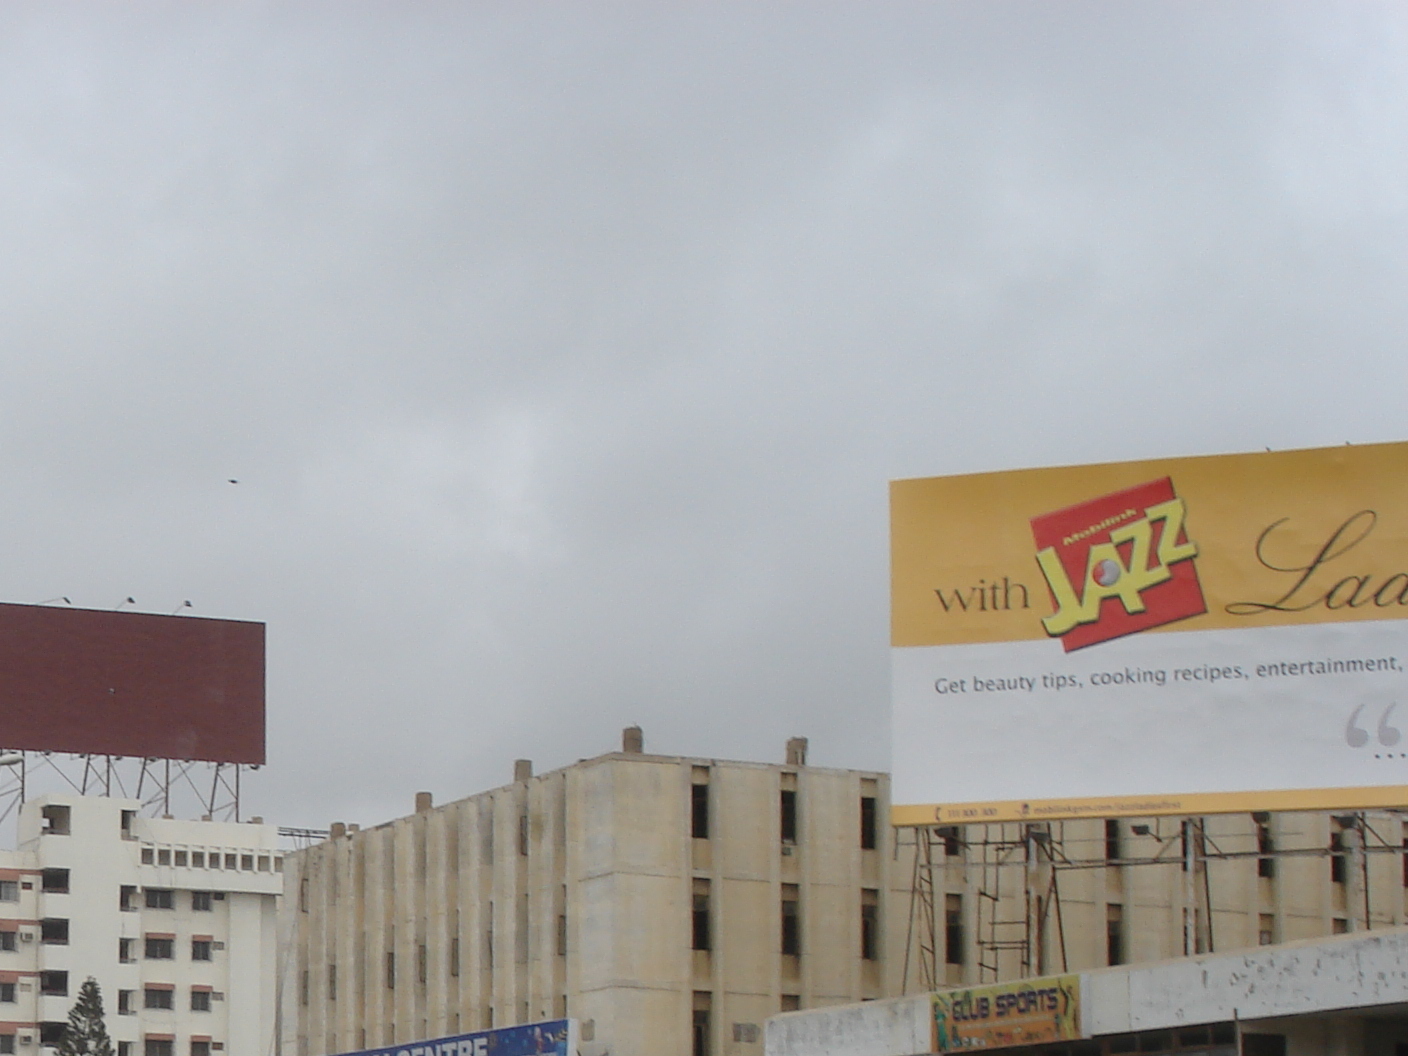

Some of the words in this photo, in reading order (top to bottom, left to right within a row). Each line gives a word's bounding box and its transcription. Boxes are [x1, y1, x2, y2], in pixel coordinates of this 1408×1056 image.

[934, 576, 1030, 613] with
[1036, 497, 1199, 638] JAZZ
[934, 676, 967, 695] Get
[973, 675, 1036, 692] beauty
[1041, 672, 1084, 690] tips,
[1089, 666, 1167, 686] cooking
[1173, 662, 1250, 684] recipes,
[1256, 655, 1404, 678] entertainment,
[995, 987, 1059, 1017] SPORTS
